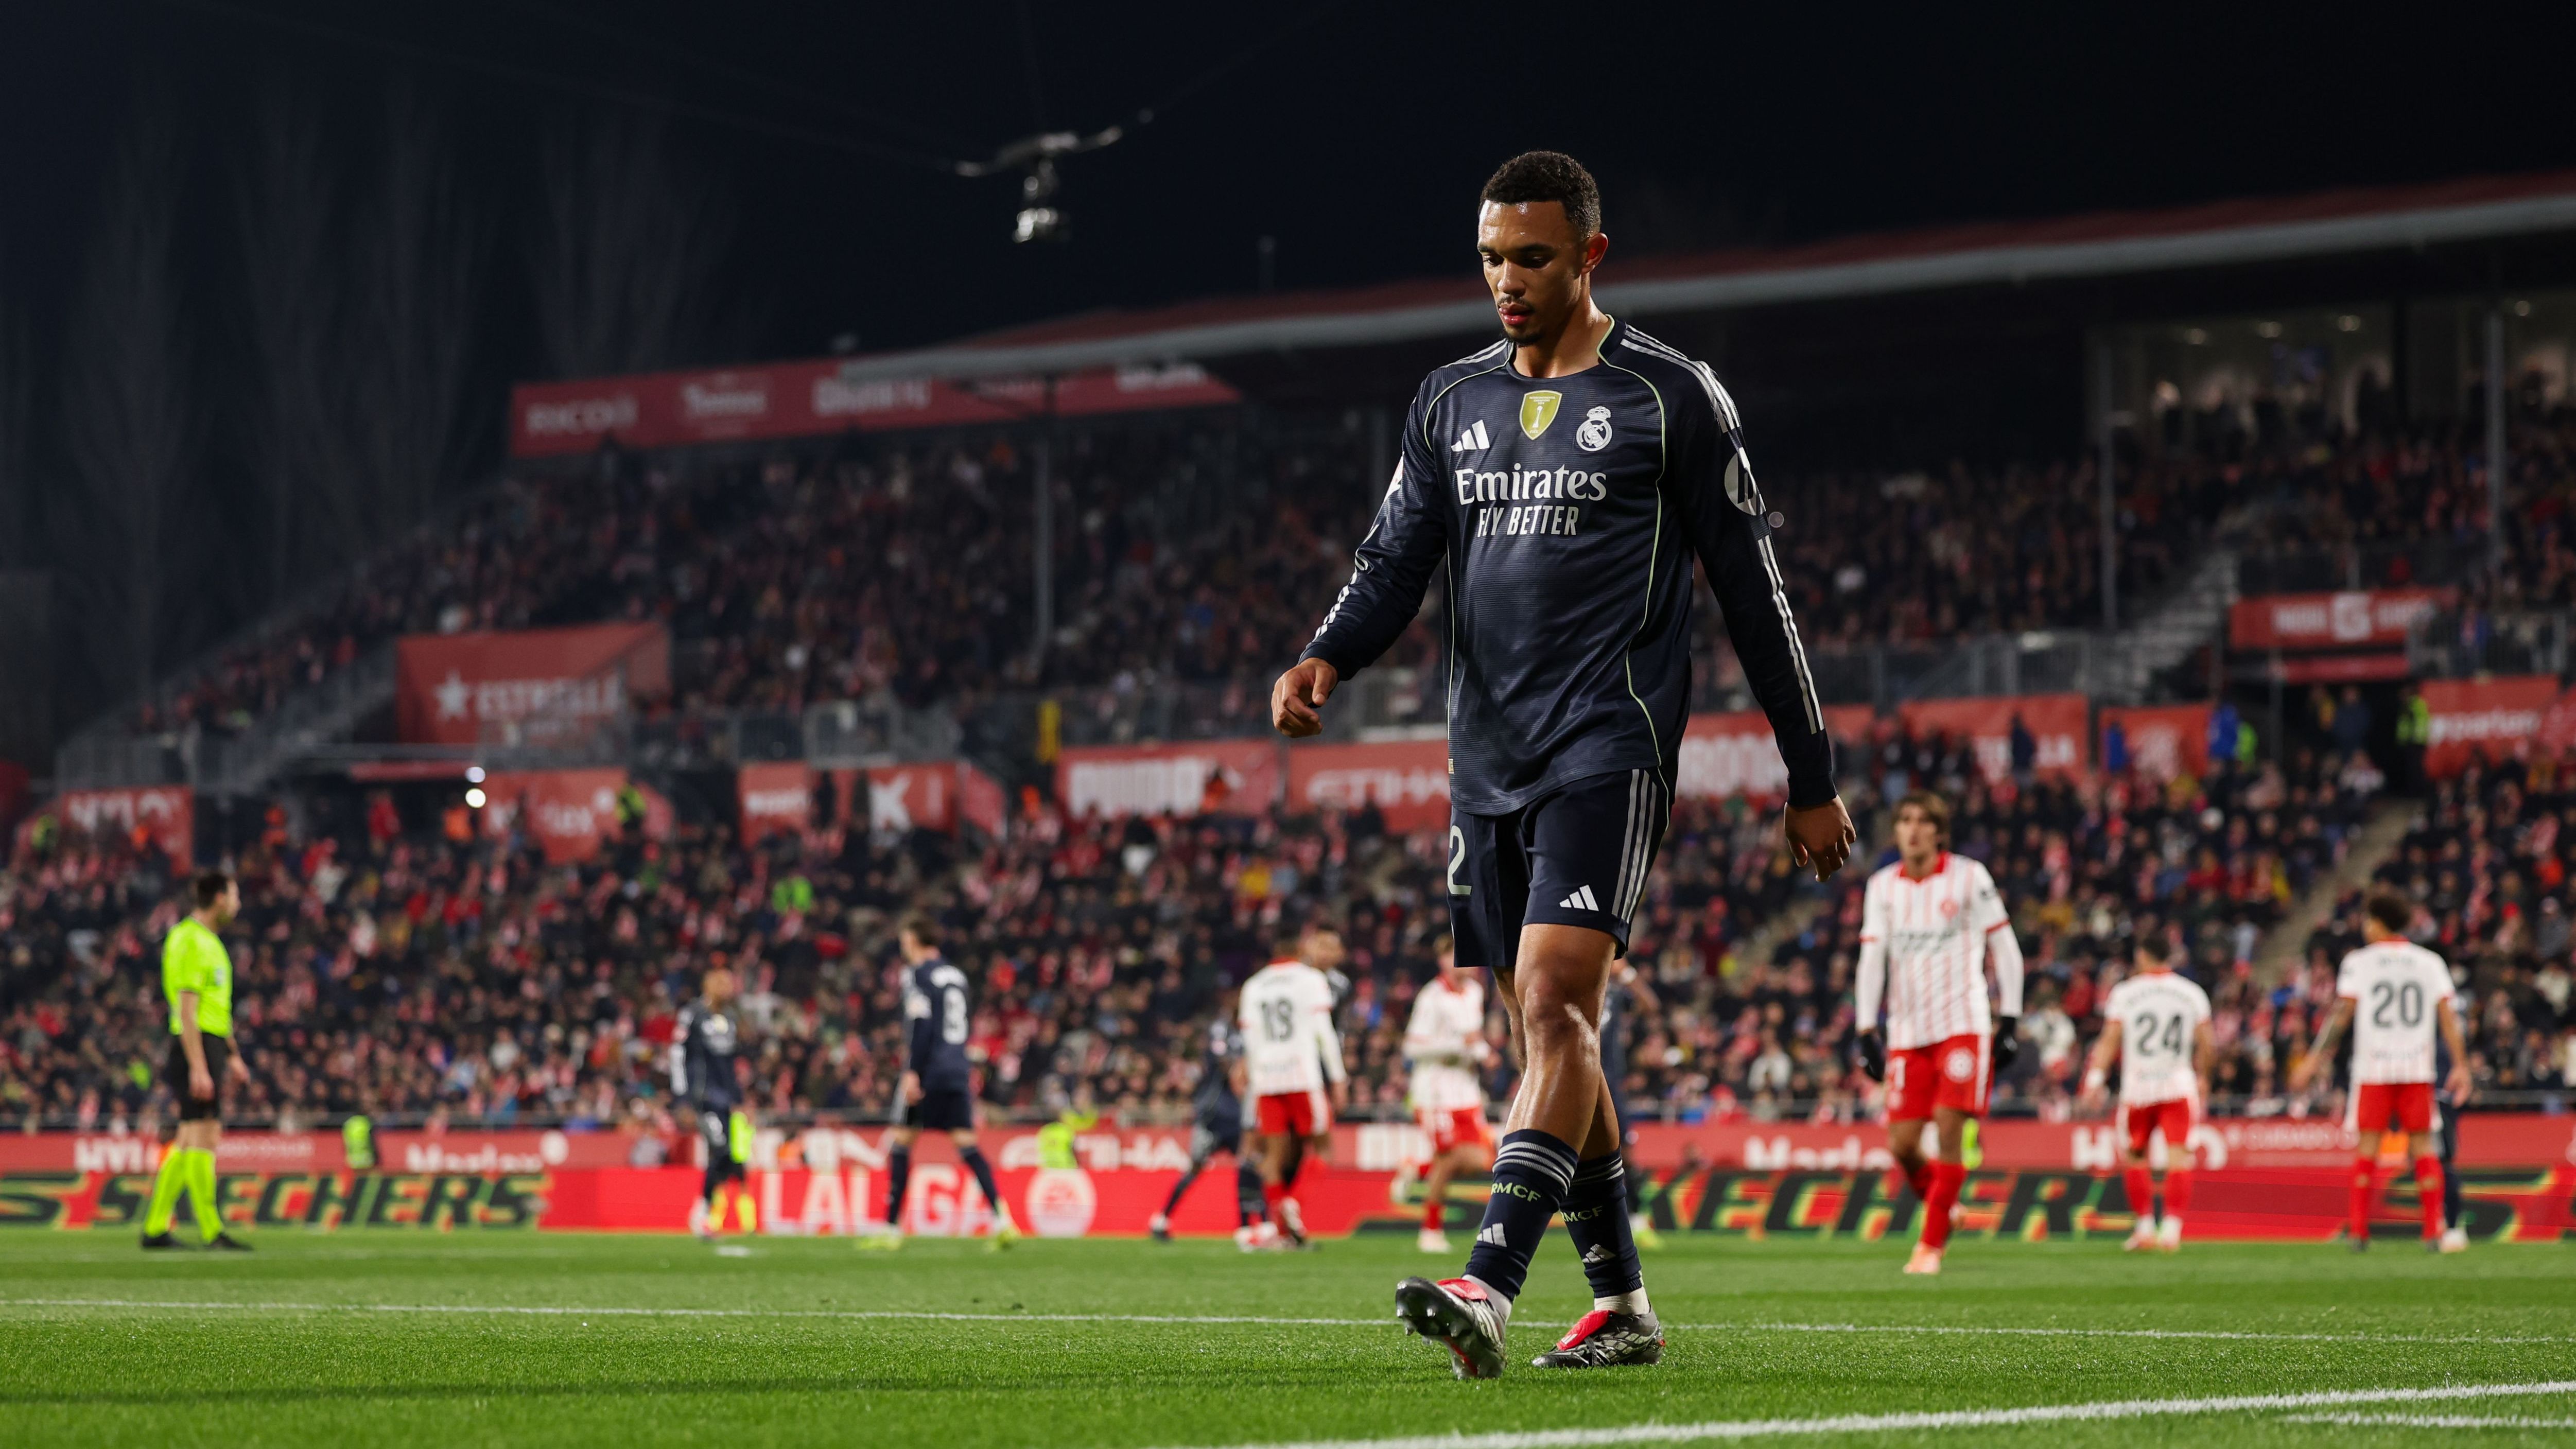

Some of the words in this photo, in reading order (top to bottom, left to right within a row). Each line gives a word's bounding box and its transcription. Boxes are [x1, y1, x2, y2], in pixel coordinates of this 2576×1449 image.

[1455, 463, 1607, 505] Emirates
[1477, 507, 1505, 537] FLY
[1506, 504, 1579, 536] BETTER
[1307, 768, 1450, 809] ETIHA
[1447, 825, 1472, 896] 2
[2371, 980, 2423, 1028] 20
[2136, 1009, 2184, 1057] 24
[762, 1163, 1000, 1235] LALGA
[1491, 1182, 1541, 1202] RMCF
